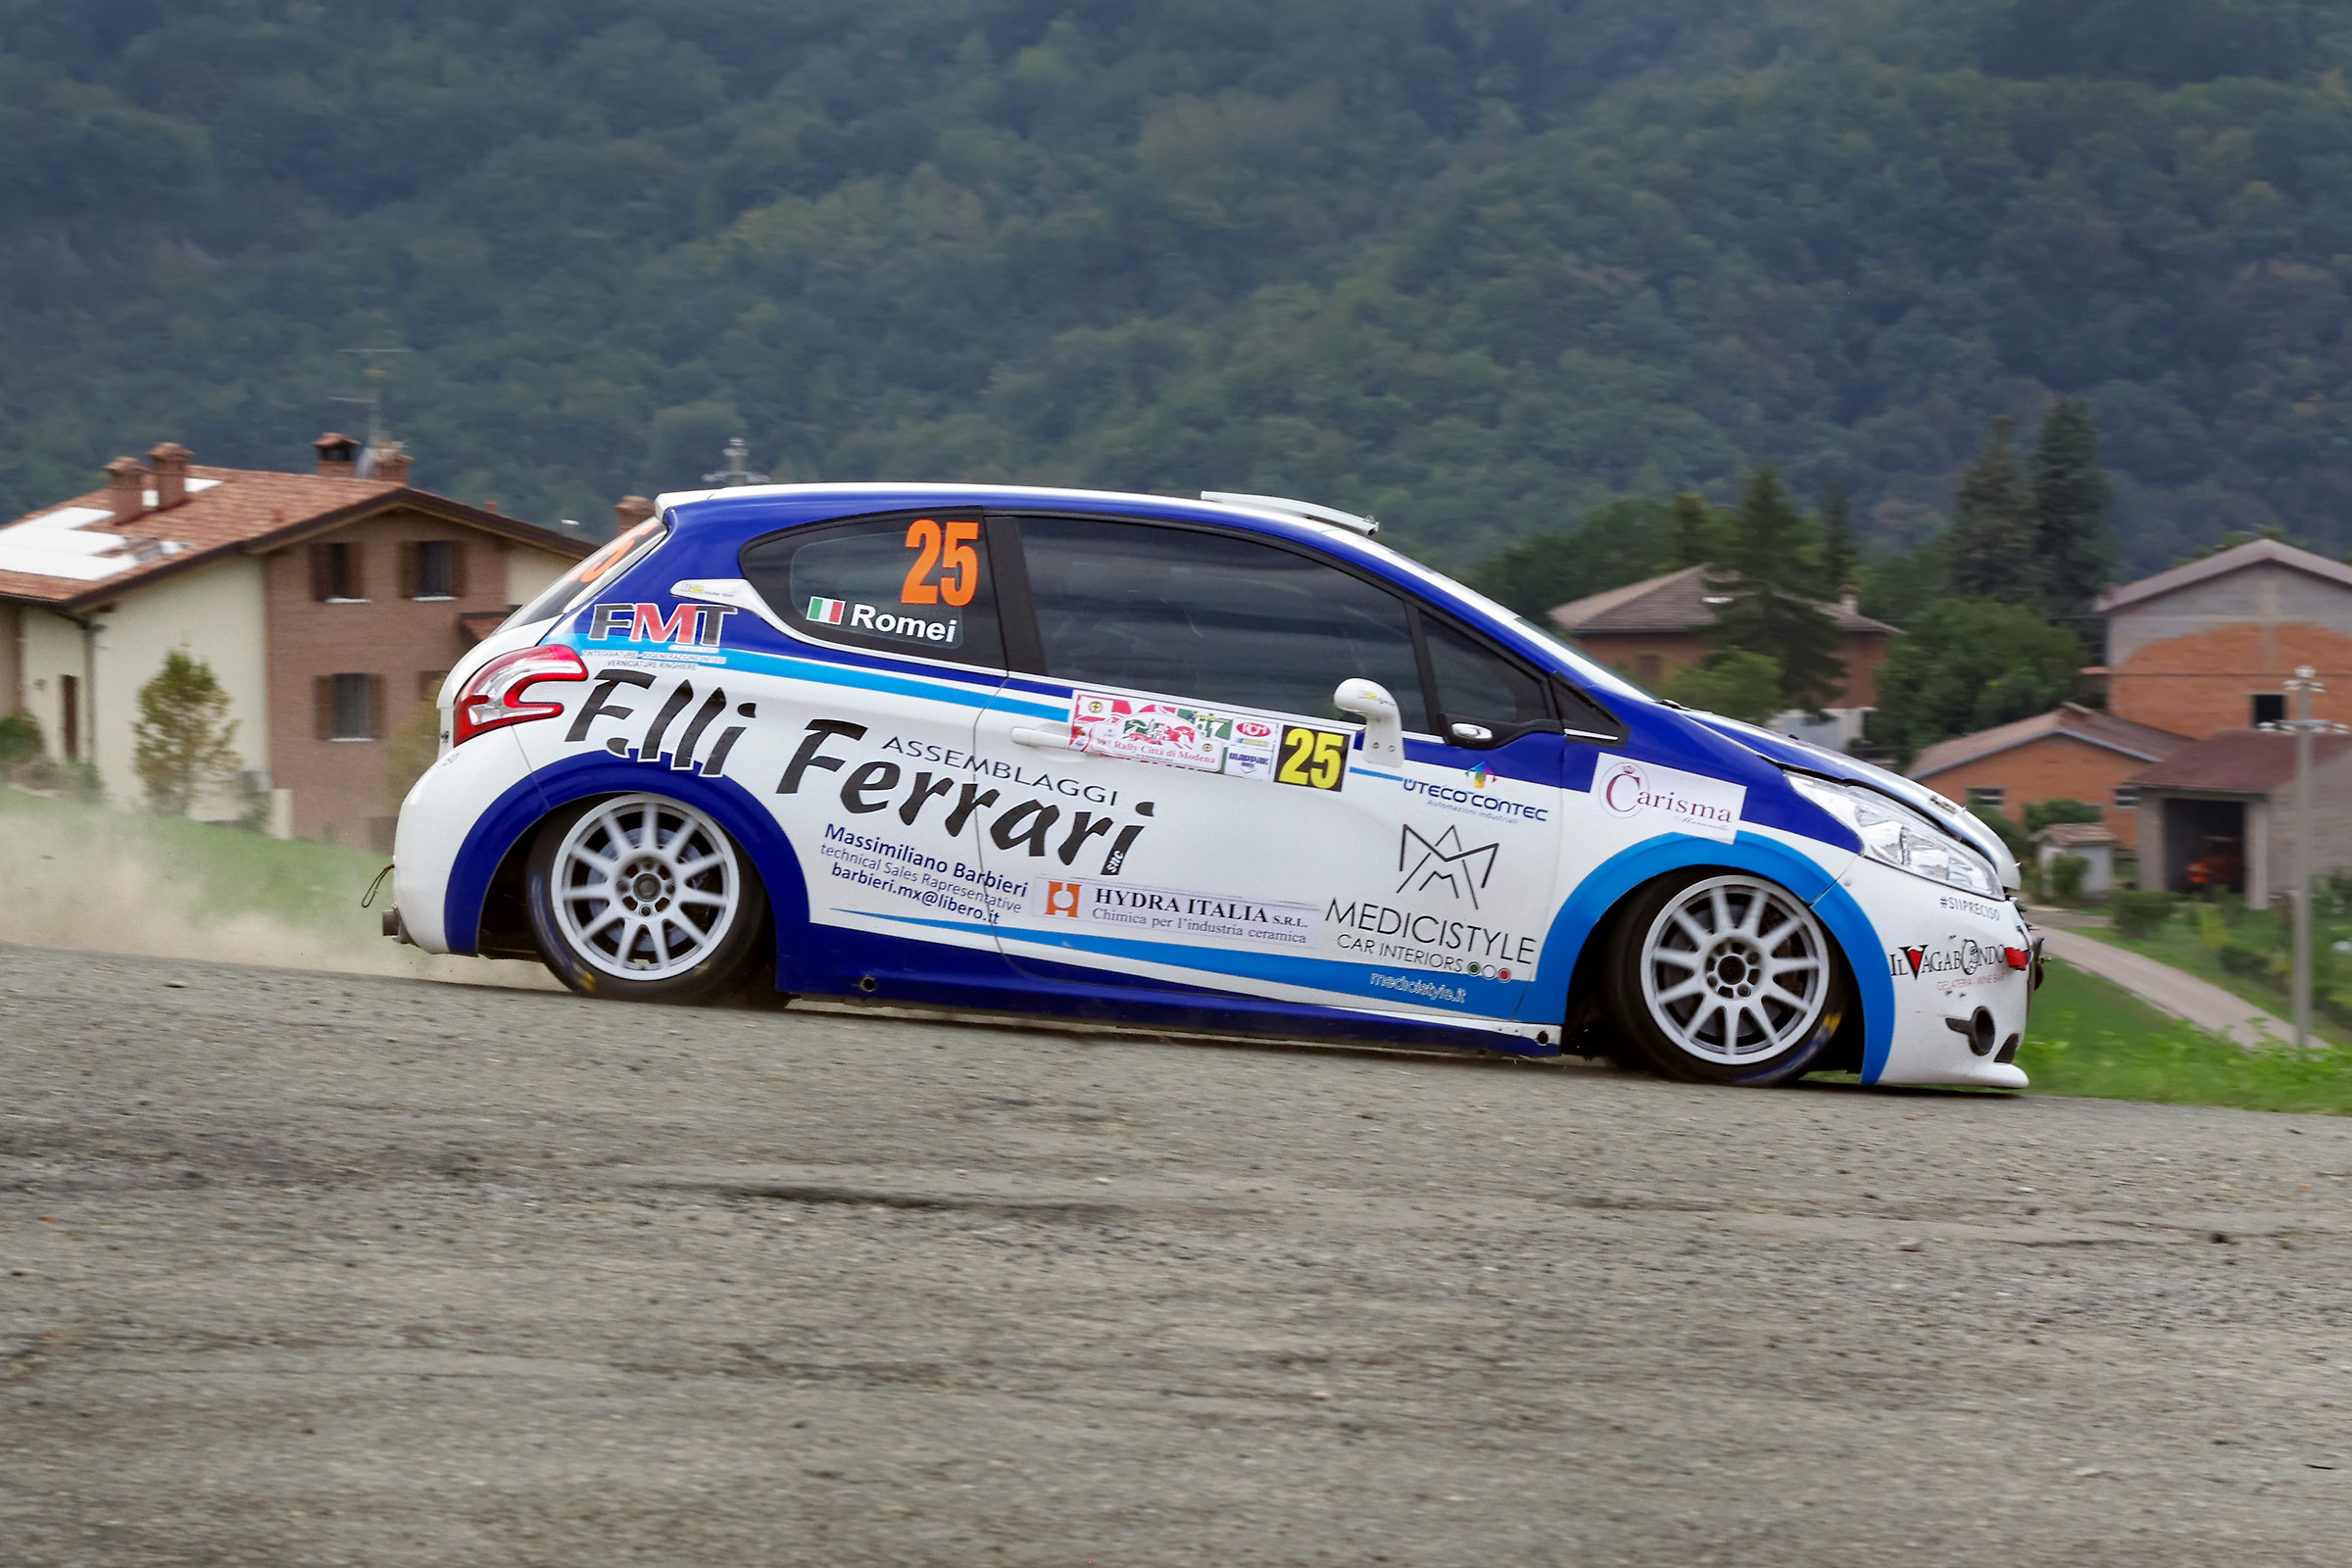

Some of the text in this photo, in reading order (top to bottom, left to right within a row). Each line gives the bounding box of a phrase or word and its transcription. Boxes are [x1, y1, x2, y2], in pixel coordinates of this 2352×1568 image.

[901, 518, 979, 607] 25
[588, 603, 738, 646] FMT
[851, 604, 957, 643] Romei
[608, 660, 698, 670] VERNICIATURE RINGHIERE
[564, 669, 1154, 875] F.lli Ferrari
[882, 736, 1118, 807] ASSEMBLAGGI
[1113, 741, 1137, 753] Rally
[1179, 751, 1216, 763] Modena
[1279, 728, 1345, 789] 25
[1471, 794, 1548, 822] CONTEC
[1606, 773, 1732, 823] Carisma
[820, 844, 1022, 913] technical Sales Rapresentative
[824, 823, 1029, 898] Massimiliano Barbieri
[832, 862, 1001, 925] barbieri.mx@libero.it
[1095, 887, 1178, 912] HYDRA
[1187, 899, 1268, 923] ITALIA
[1093, 907, 1307, 944] Chimica per l'industria ceramica
[1325, 897, 1537, 964] MEDICISTYLE
[1337, 934, 1464, 973] CAR INTERIORS
[1370, 972, 1467, 1004] medicistyle.it
